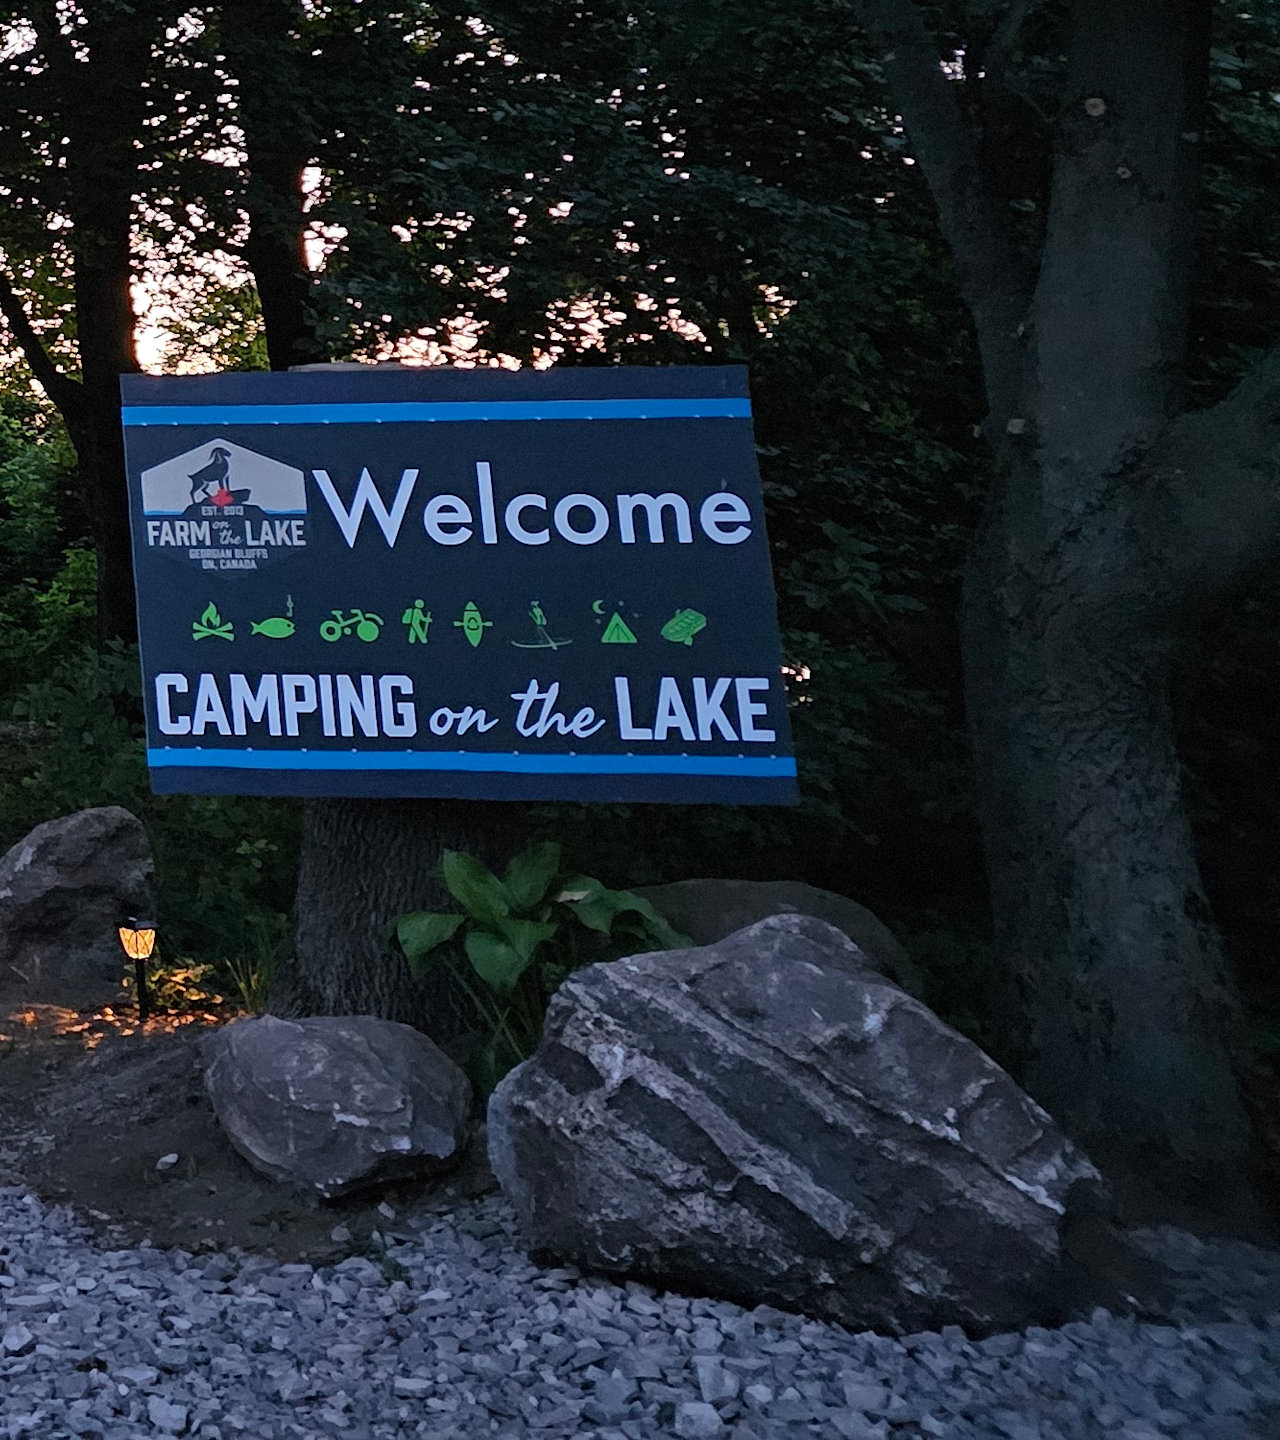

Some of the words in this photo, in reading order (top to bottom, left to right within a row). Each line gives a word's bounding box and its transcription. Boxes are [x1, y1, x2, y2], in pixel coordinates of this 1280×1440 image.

[311, 461, 753, 549] Welcome
[148, 520, 212, 546] FARM
[212, 520, 231, 530] on
[219, 530, 243, 546] the
[245, 520, 307, 546] LAKE
[220, 560, 257, 569] CANADA
[155, 672, 417, 739] CAMPING
[429, 703, 498, 736] on
[510, 678, 608, 739] the
[616, 676, 777, 743] LAKE
